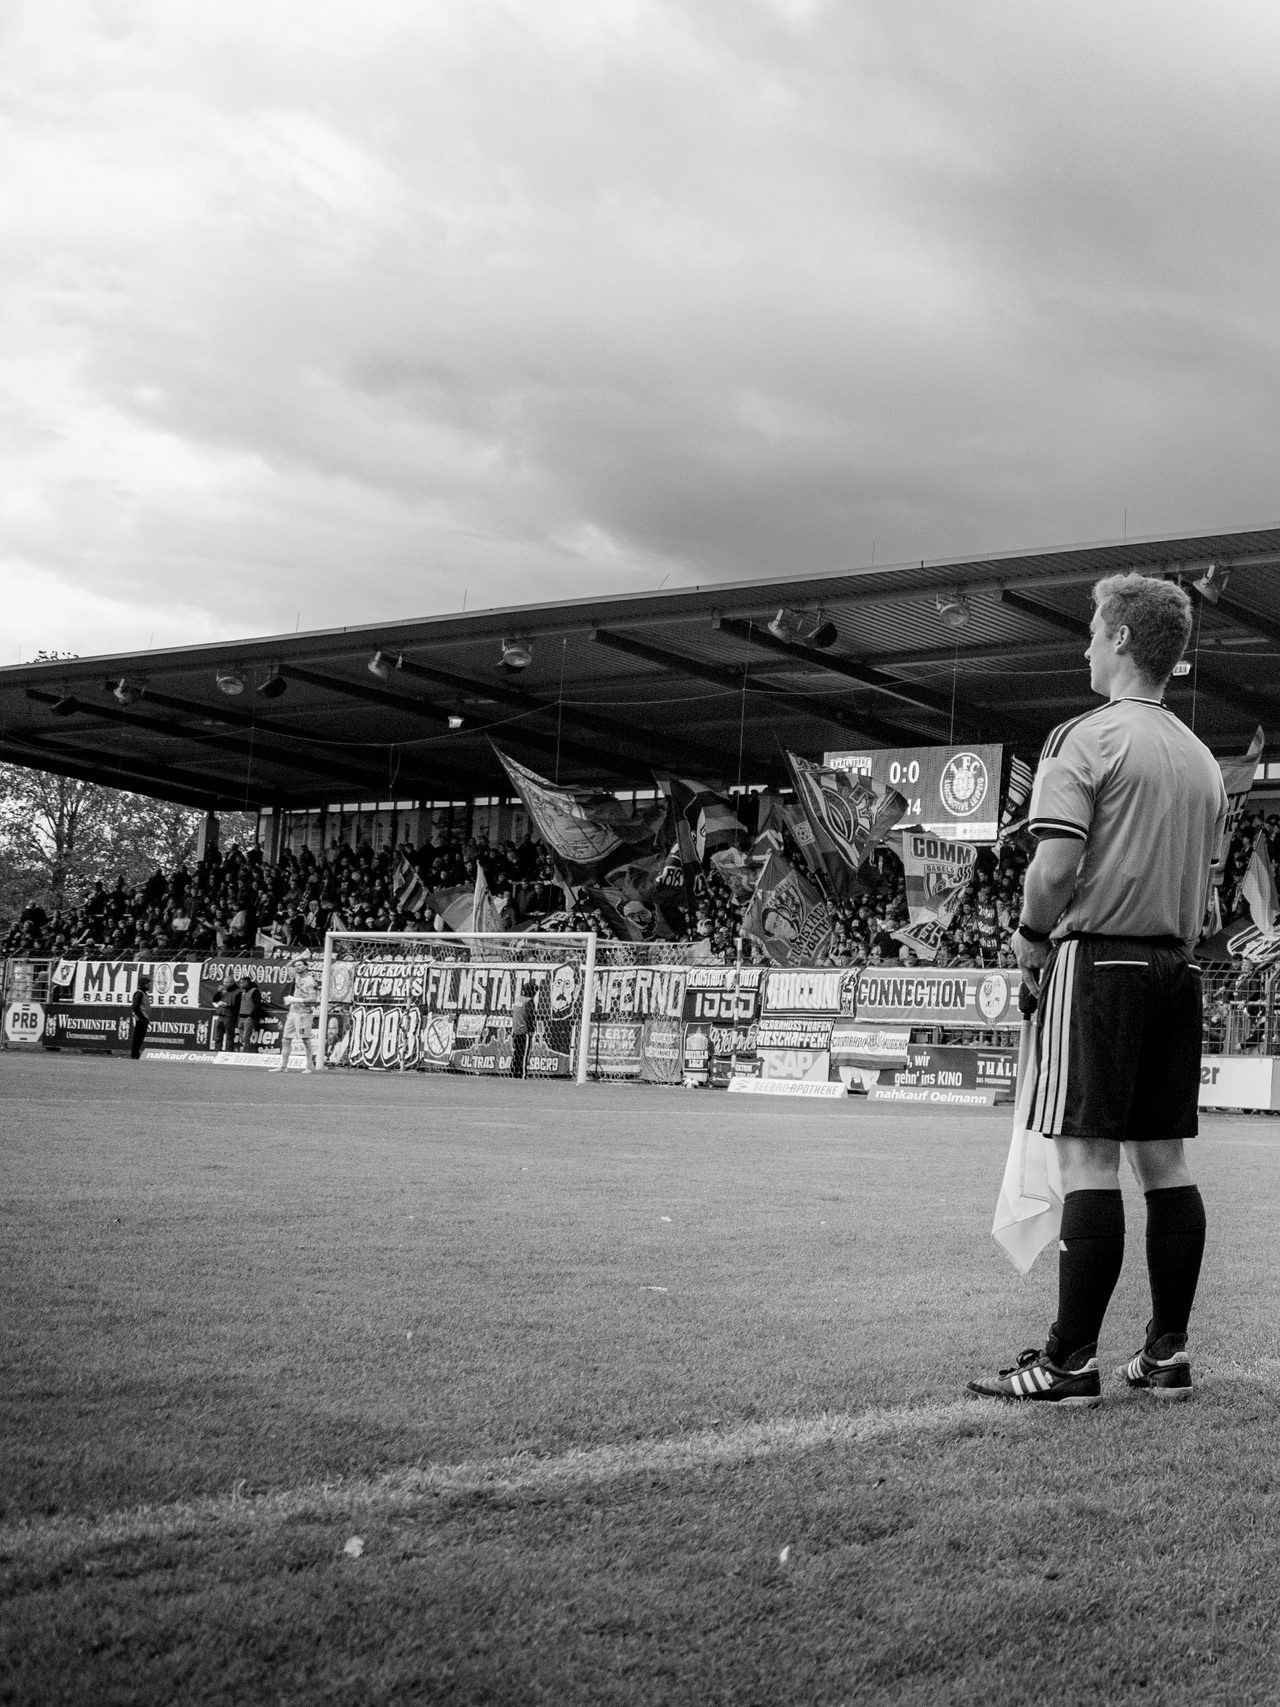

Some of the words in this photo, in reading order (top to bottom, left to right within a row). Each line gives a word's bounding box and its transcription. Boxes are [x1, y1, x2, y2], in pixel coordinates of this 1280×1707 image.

[856, 978, 968, 1010] CONNECTION
[12, 1012, 38, 1029] PRB
[937, 1071, 963, 1087] KINO
[876, 1089, 928, 1101] nahkauf
[930, 1091, 988, 1105] Oelmann
